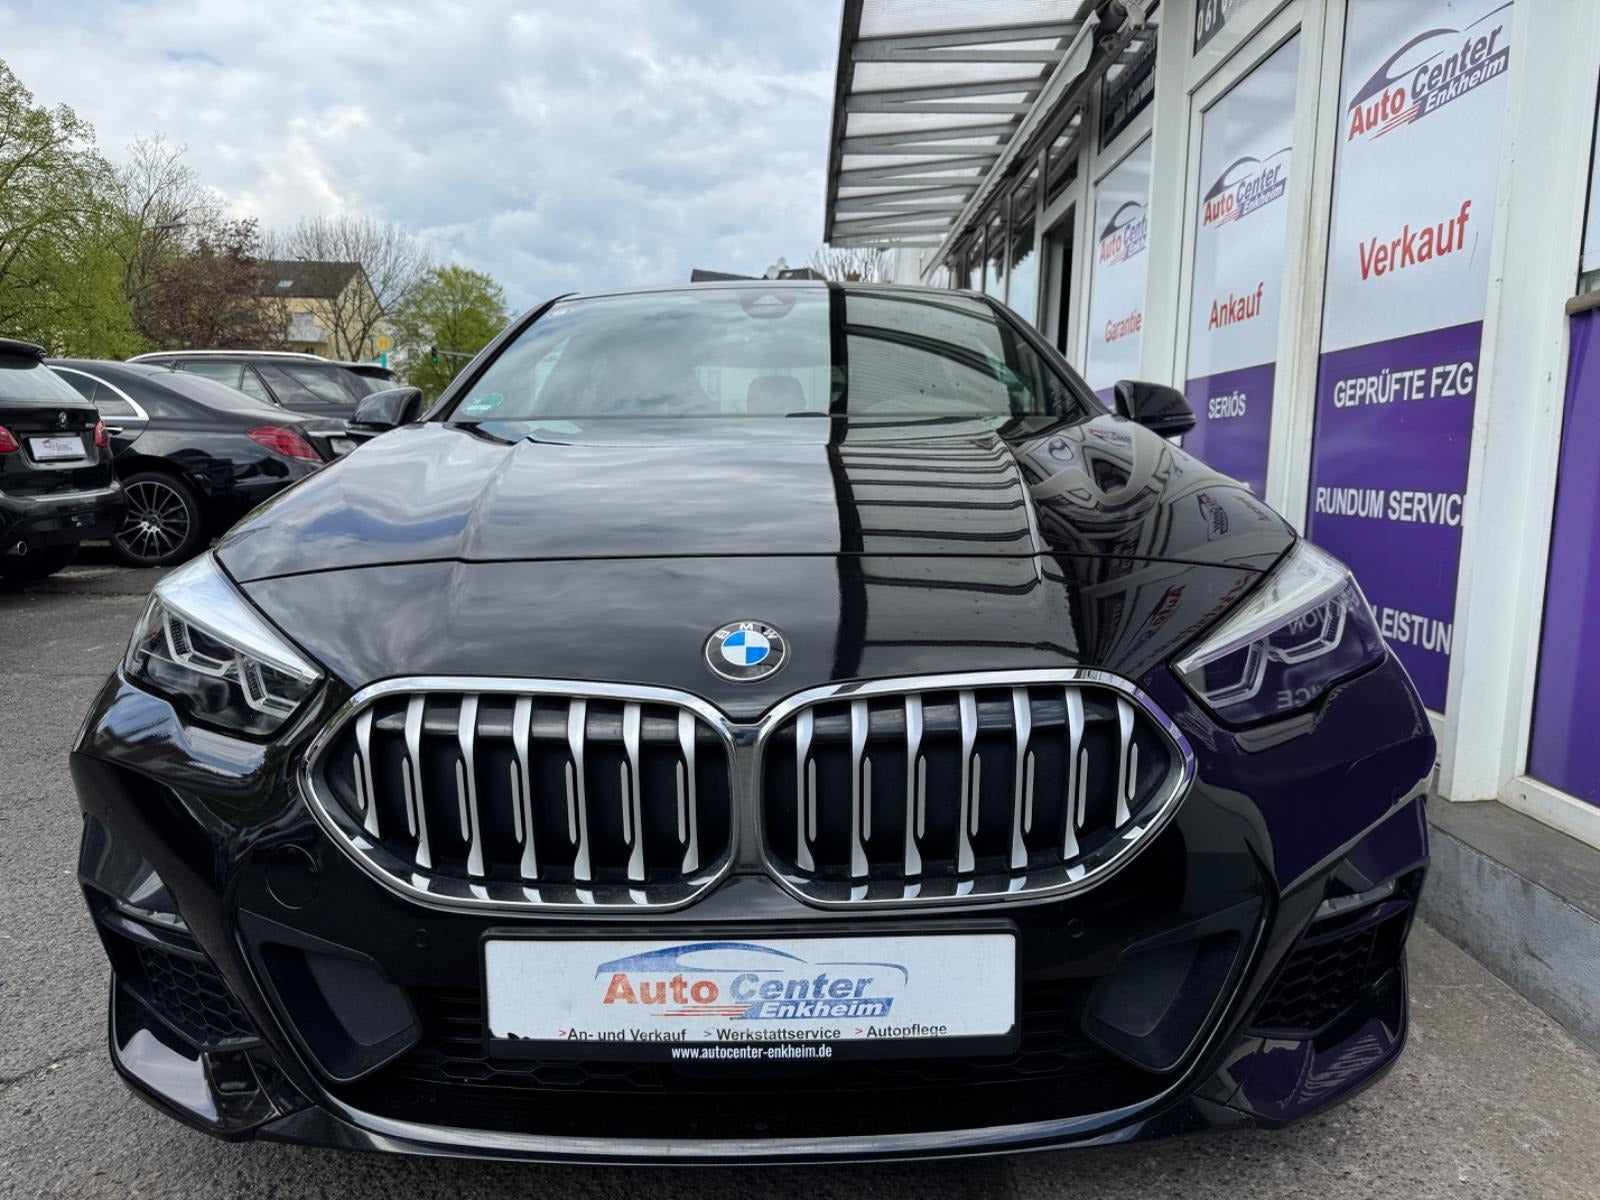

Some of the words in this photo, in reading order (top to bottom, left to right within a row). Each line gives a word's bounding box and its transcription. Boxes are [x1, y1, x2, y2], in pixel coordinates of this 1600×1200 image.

[1348, 87, 1405, 142] Auto
[1411, 25, 1503, 100] Center
[1424, 57, 1506, 113] Enkheim
[1203, 193, 1234, 227] Auto
[1236, 163, 1282, 205] Center
[1099, 233, 1121, 264] Auto
[1124, 213, 1148, 247] Cent
[1359, 199, 1472, 281] Verkauf
[1105, 309, 1142, 343] Garantie
[1208, 281, 1264, 331] Ankauf
[1208, 390, 1247, 420] SERIÖS
[1333, 368, 1427, 409] GEPRÜFTE
[1430, 361, 1474, 399] FZG
[1315, 486, 1385, 519] RUNDUM
[1387, 490, 1464, 527] SERVIC
[715, 622, 779, 640] BMW
[603, 973, 719, 1005] Auto
[729, 972, 874, 1000] Center
[759, 1001, 884, 1018] Enkheim
[567, 1028, 594, 1041] An-
[597, 1028, 625, 1041] und
[629, 1028, 688, 1042] Verkauf
[716, 1027, 841, 1041] Werkstattservice
[866, 1023, 948, 1039] Autopflege
[671, 1044, 833, 1060] www.autocenter-enkheim.de
